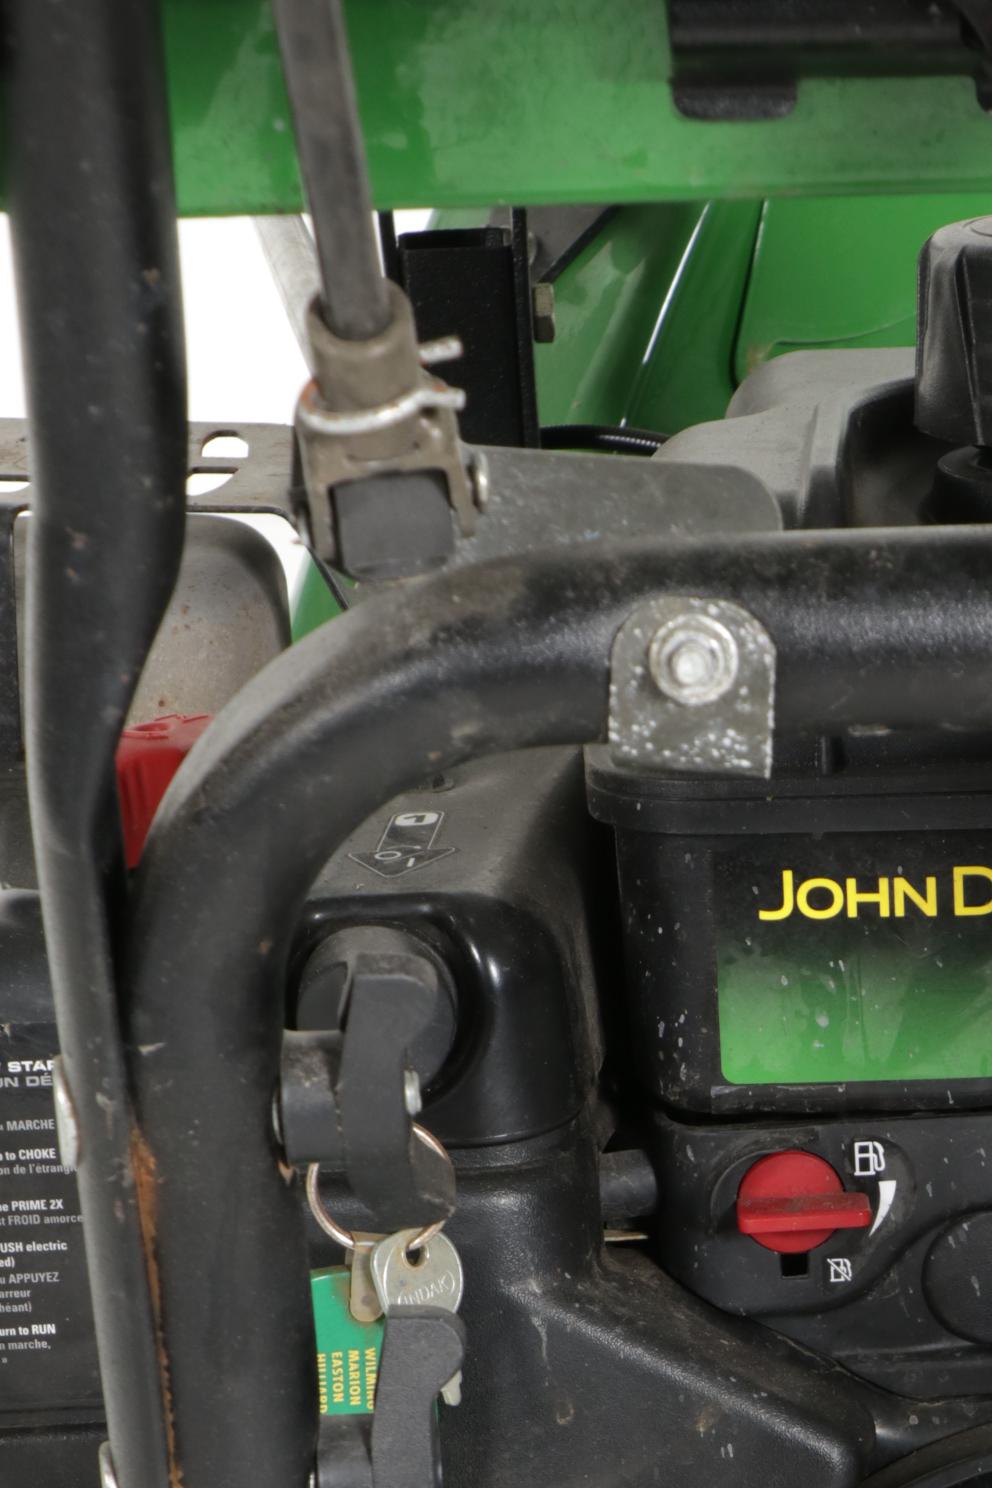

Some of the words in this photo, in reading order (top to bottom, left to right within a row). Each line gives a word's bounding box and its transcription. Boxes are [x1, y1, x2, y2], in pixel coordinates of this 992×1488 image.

[758, 869, 938, 920] JOHN
[6, 1119, 56, 1132] MARCHE
[5, 1151, 16, 1161] to
[19, 1148, 56, 1160] CHOKE
[14, 1164, 26, 1175] de
[11, 1199, 48, 1212] PRIME
[49, 1198, 64, 1210] 2X
[8, 1213, 41, 1226] FROID
[26, 1239, 68, 1252] electric
[9, 1271, 60, 1284] APPUYEZ
[18, 1326, 29, 1336] to
[31, 1323, 56, 1335] RUN
[332, 1351, 344, 1403] EASTON
[348, 1349, 361, 1406] MARION
